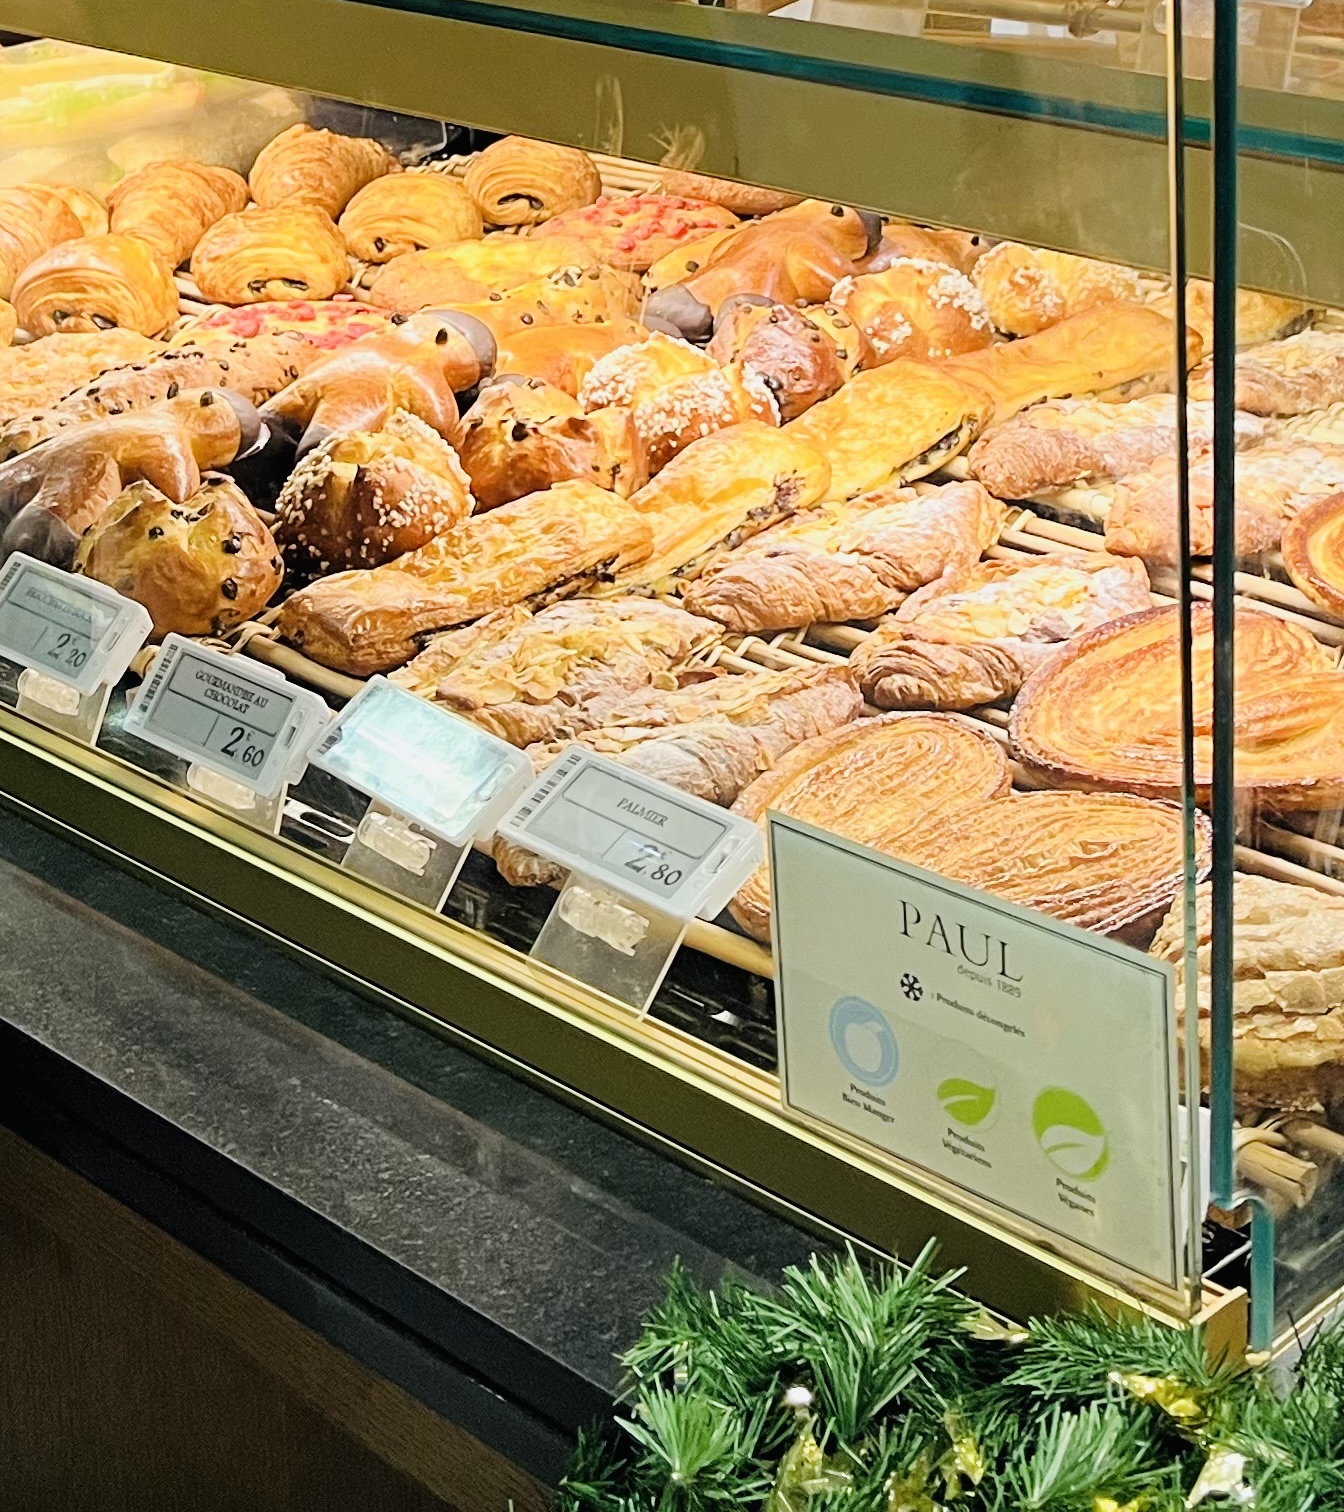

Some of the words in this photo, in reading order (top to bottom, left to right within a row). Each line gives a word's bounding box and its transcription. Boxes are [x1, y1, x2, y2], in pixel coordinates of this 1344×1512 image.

[194, 670, 255, 704] GOURMANDISE
[254, 693, 270, 709] AU
[203, 686, 251, 716] CHOCOLAT
[616, 796, 670, 829] PALMIER
[899, 900, 1024, 982] PAUL
[957, 965, 993, 987] depuis
